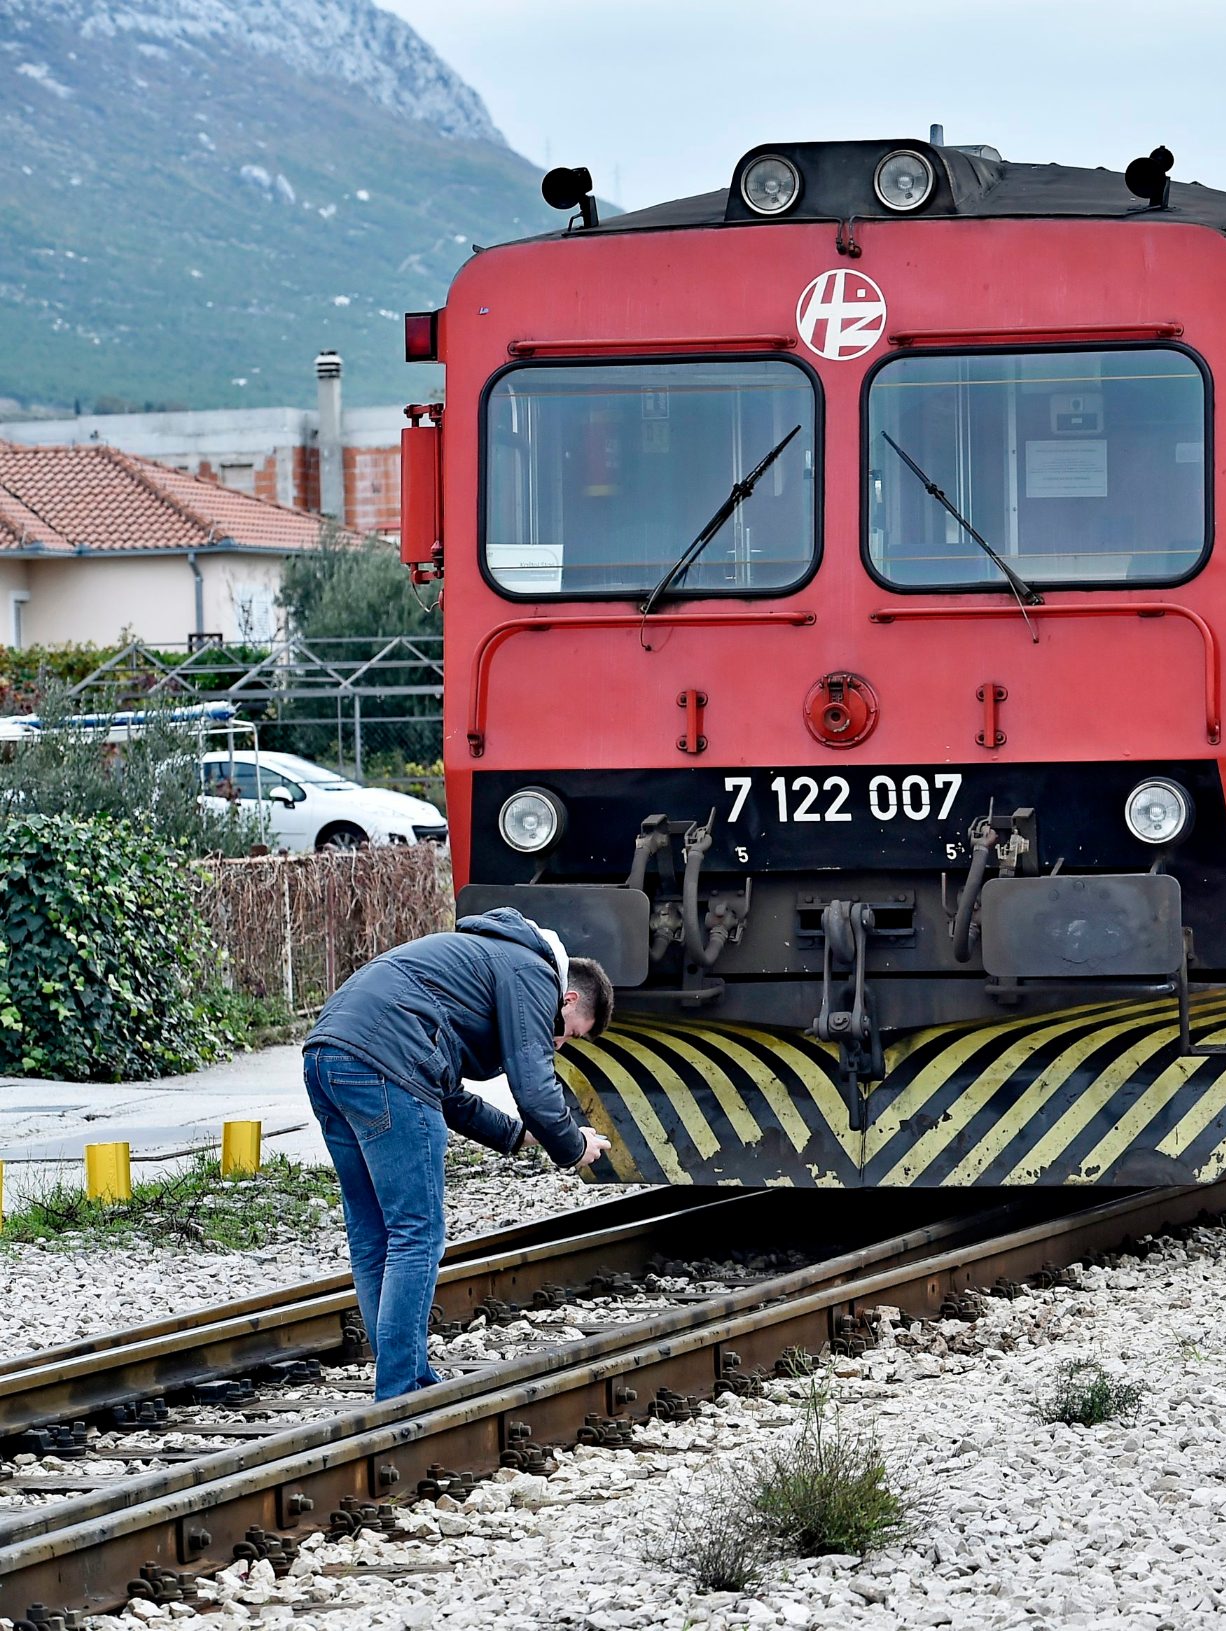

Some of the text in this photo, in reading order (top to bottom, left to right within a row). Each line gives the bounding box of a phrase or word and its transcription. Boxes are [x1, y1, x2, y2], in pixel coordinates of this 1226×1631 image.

[724, 773, 963, 823] 7 122 007
[736, 846, 749, 863] 5
[946, 843, 957, 860] 5
